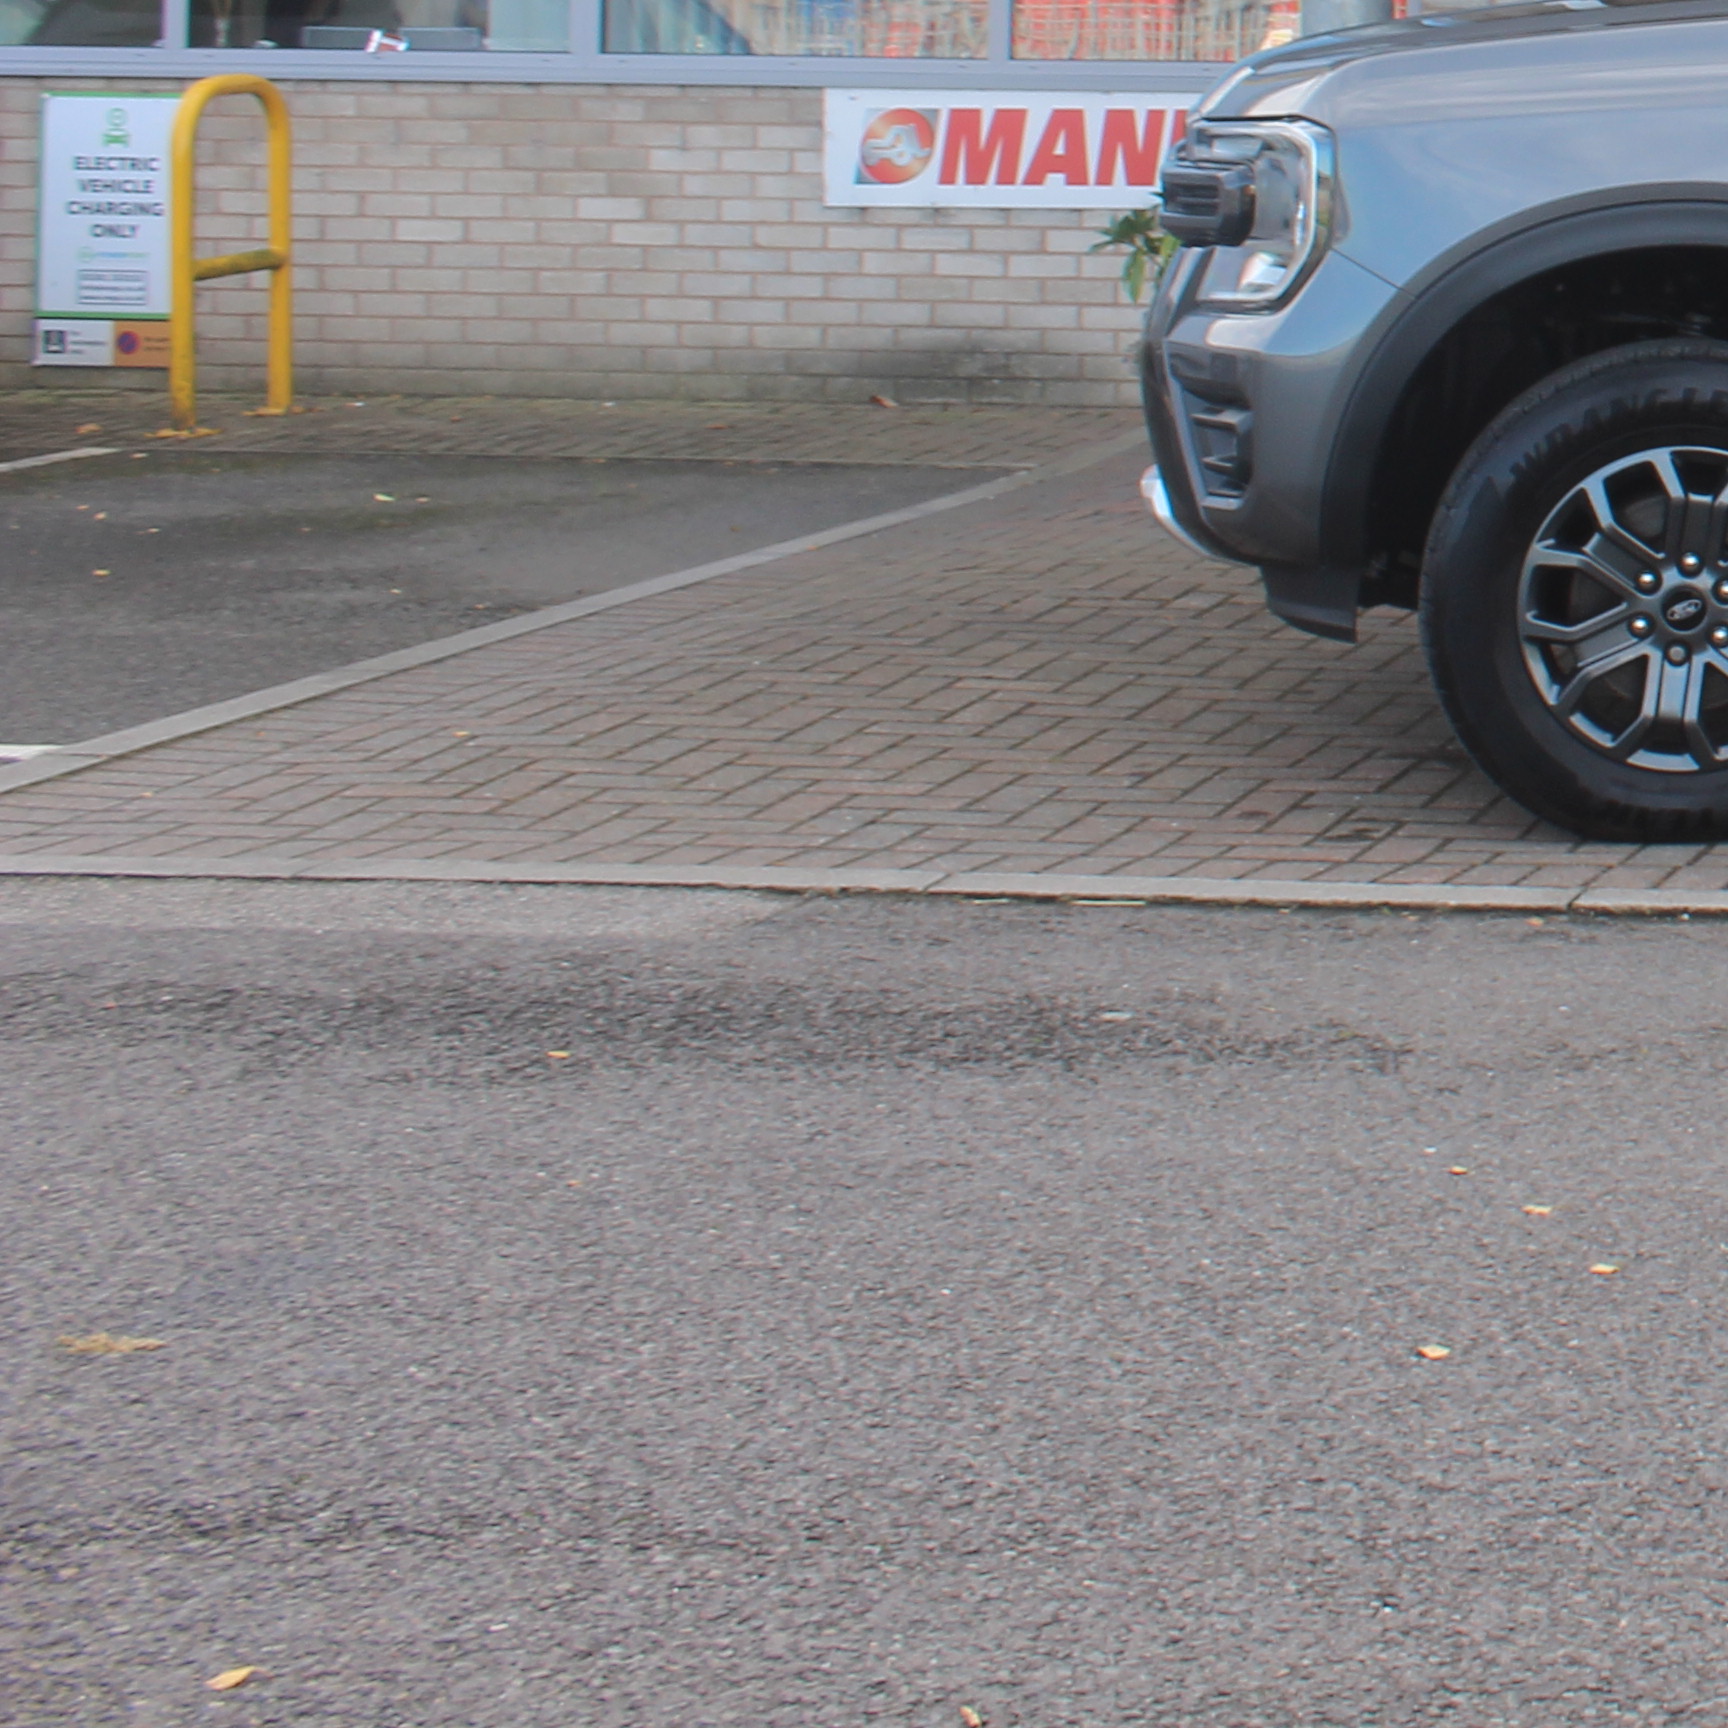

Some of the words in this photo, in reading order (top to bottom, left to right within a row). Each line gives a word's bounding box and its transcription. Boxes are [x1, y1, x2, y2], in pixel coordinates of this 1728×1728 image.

[73, 156, 161, 171] ELECTRIC
[78, 179, 155, 194] VEHICLE
[66, 201, 165, 216] CHARGING
[89, 224, 140, 238] ONLY
